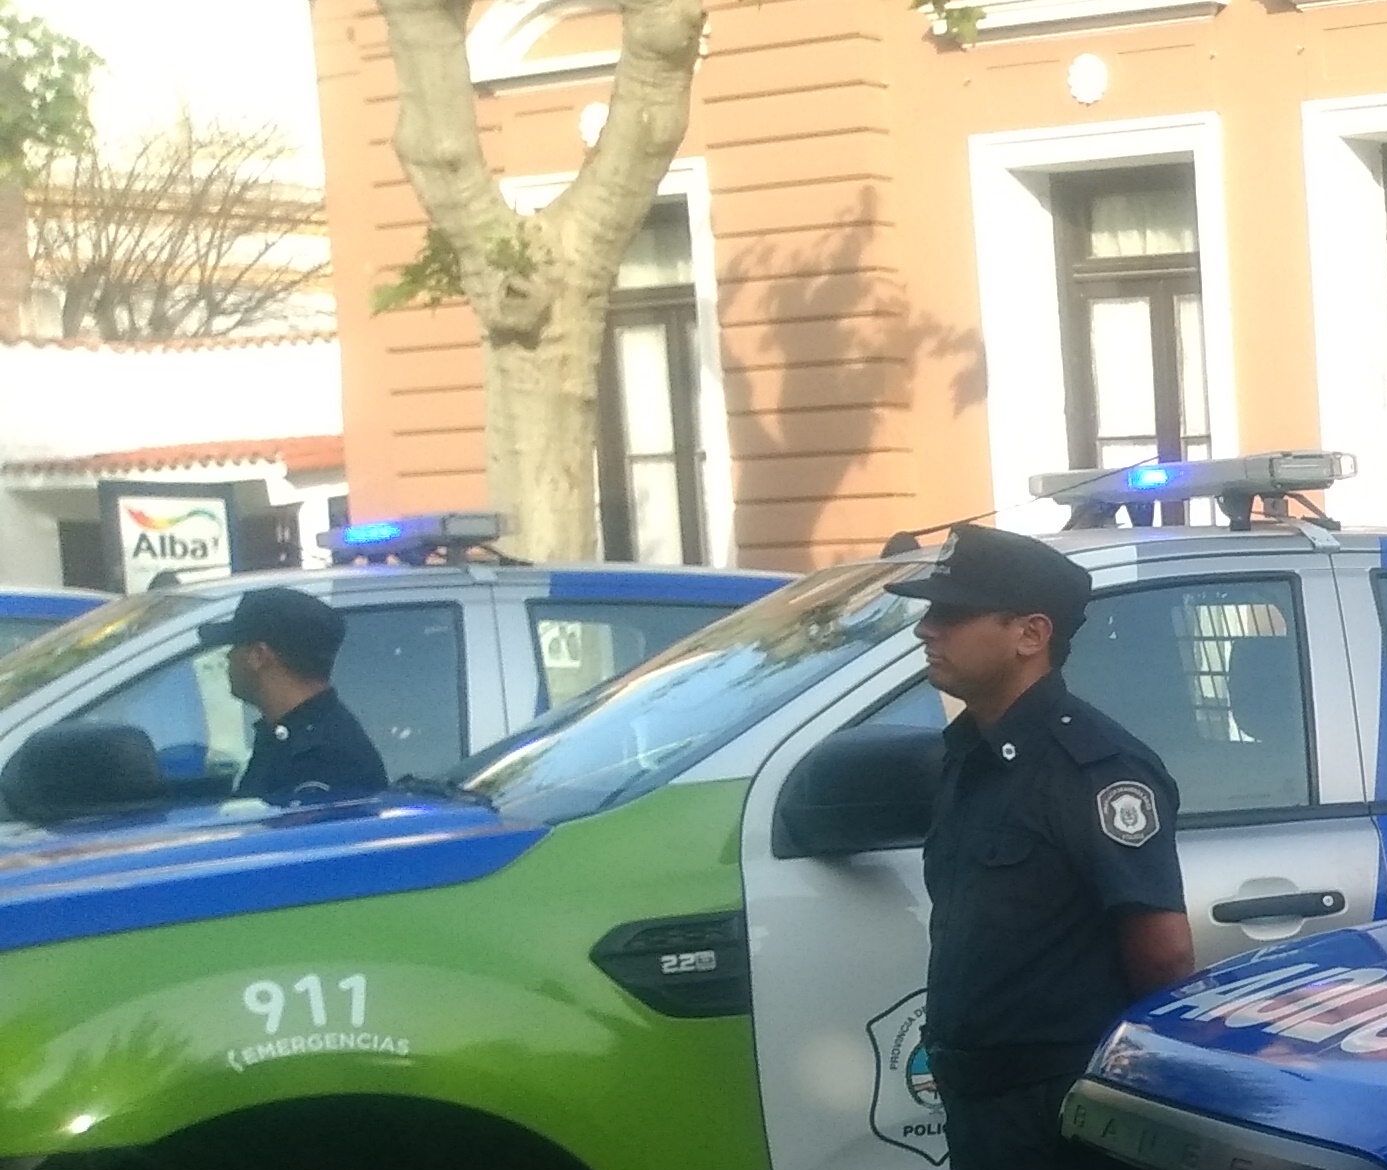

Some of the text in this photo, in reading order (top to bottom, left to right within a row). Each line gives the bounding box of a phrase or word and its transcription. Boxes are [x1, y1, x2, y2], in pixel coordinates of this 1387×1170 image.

[132, 532, 208, 559] Alba
[244, 973, 366, 1035] 911
[242, 1032, 410, 1066] EMERGENCIAS
[889, 1016, 916, 1070] PROVINCIA
